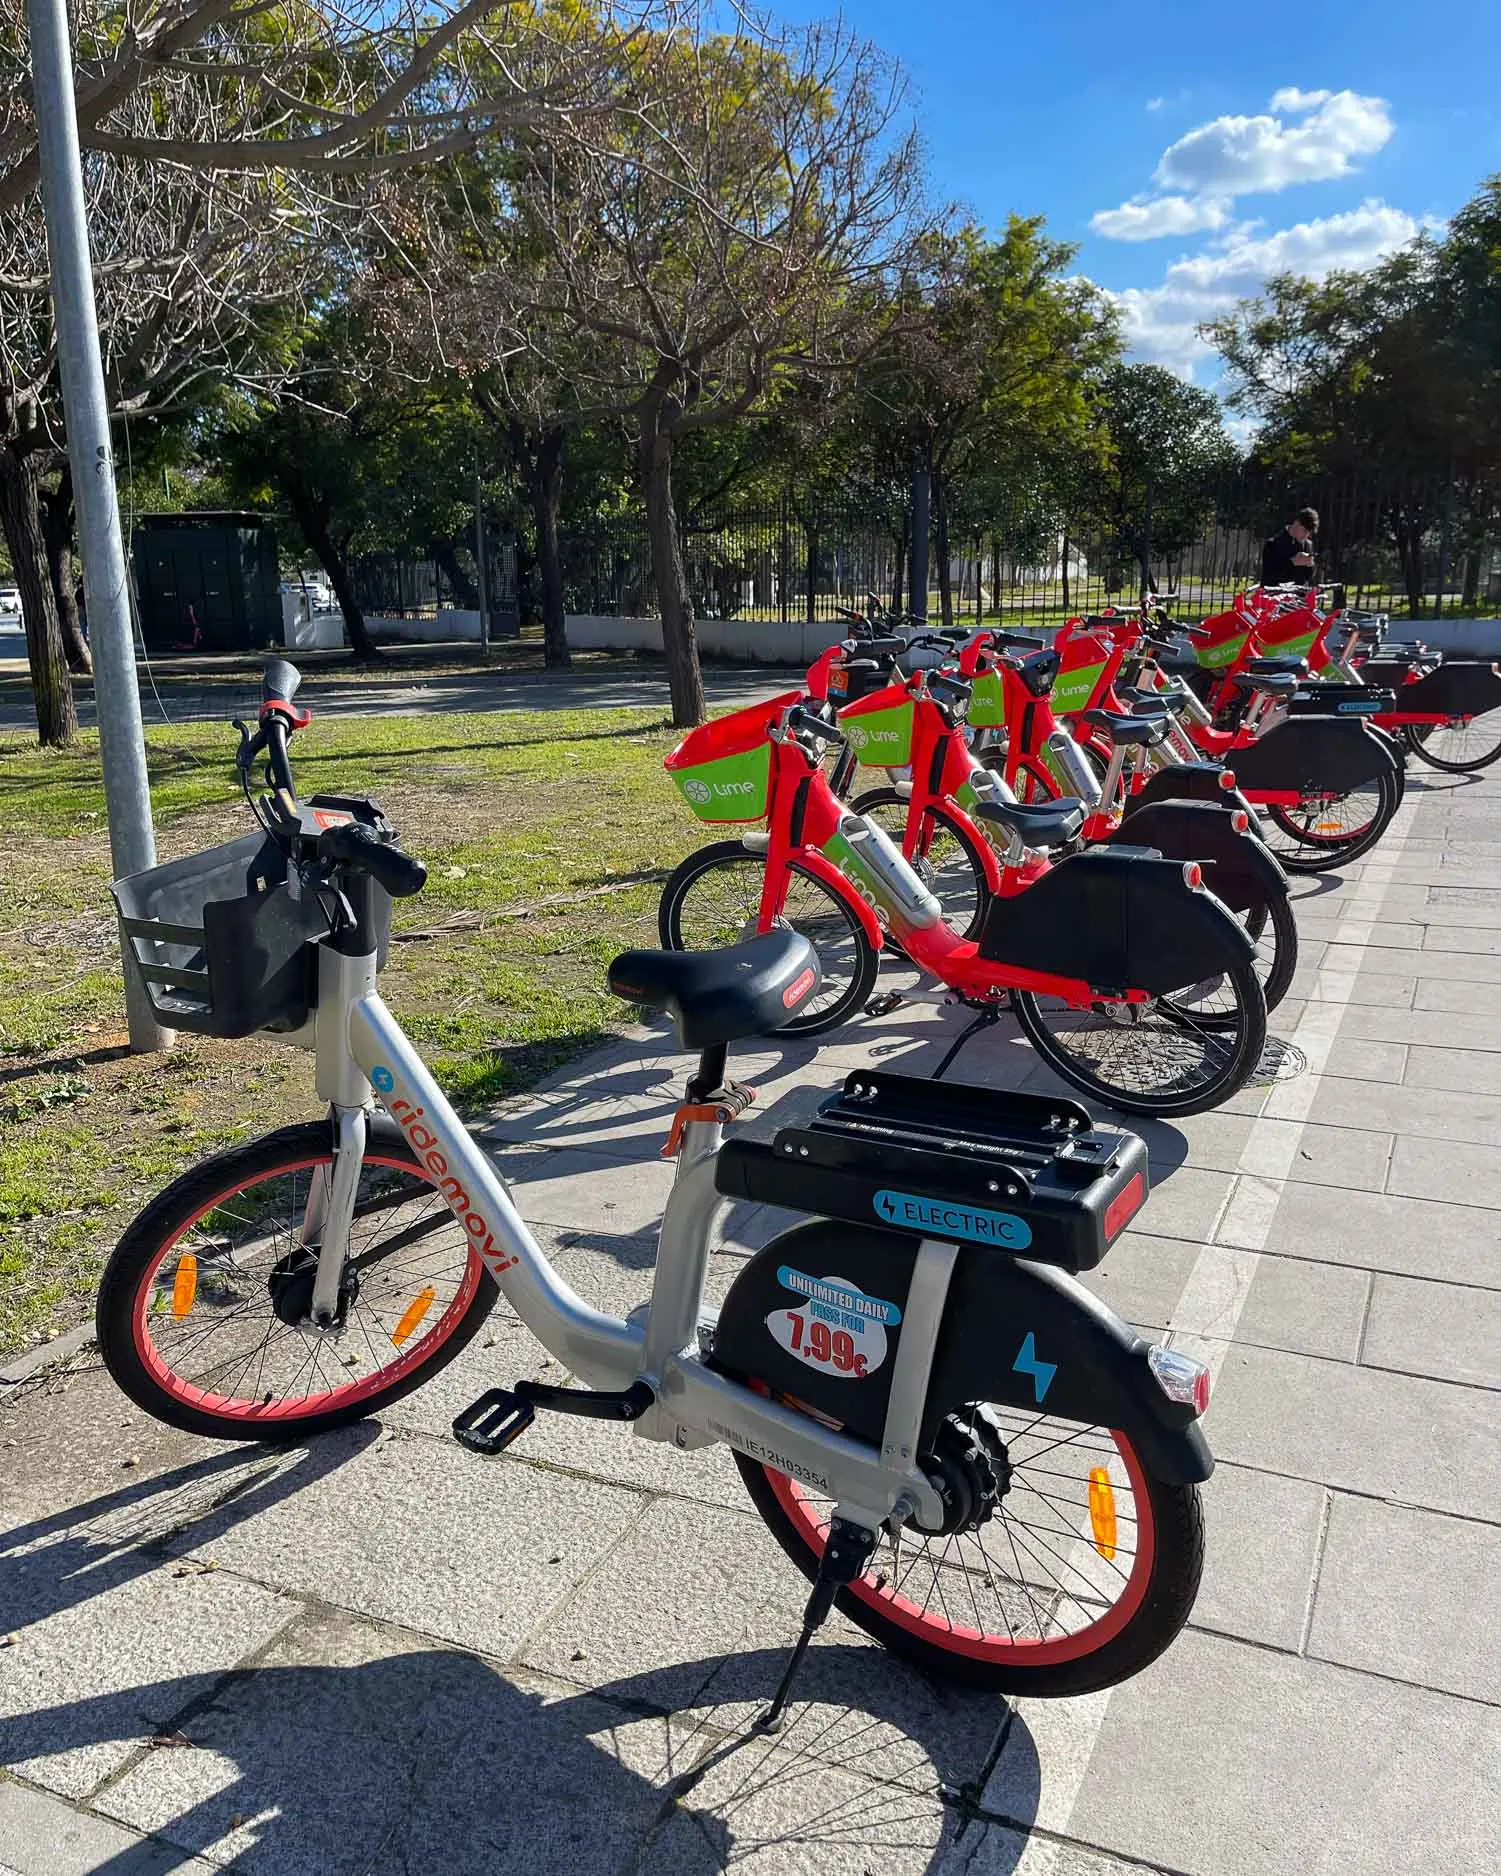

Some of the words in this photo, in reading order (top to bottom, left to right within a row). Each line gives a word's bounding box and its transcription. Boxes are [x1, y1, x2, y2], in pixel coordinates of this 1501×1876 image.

[391, 1099, 520, 1274] ridemovi
[904, 1202, 1015, 1240] ELECTRIC
[810, 1300, 840, 1325] PASS
[841, 1312, 865, 1335] FOR
[855, 1298, 889, 1321] DAILY
[786, 1311, 868, 1378] 7,99€
[745, 1439, 828, 1489] IE12H03354
